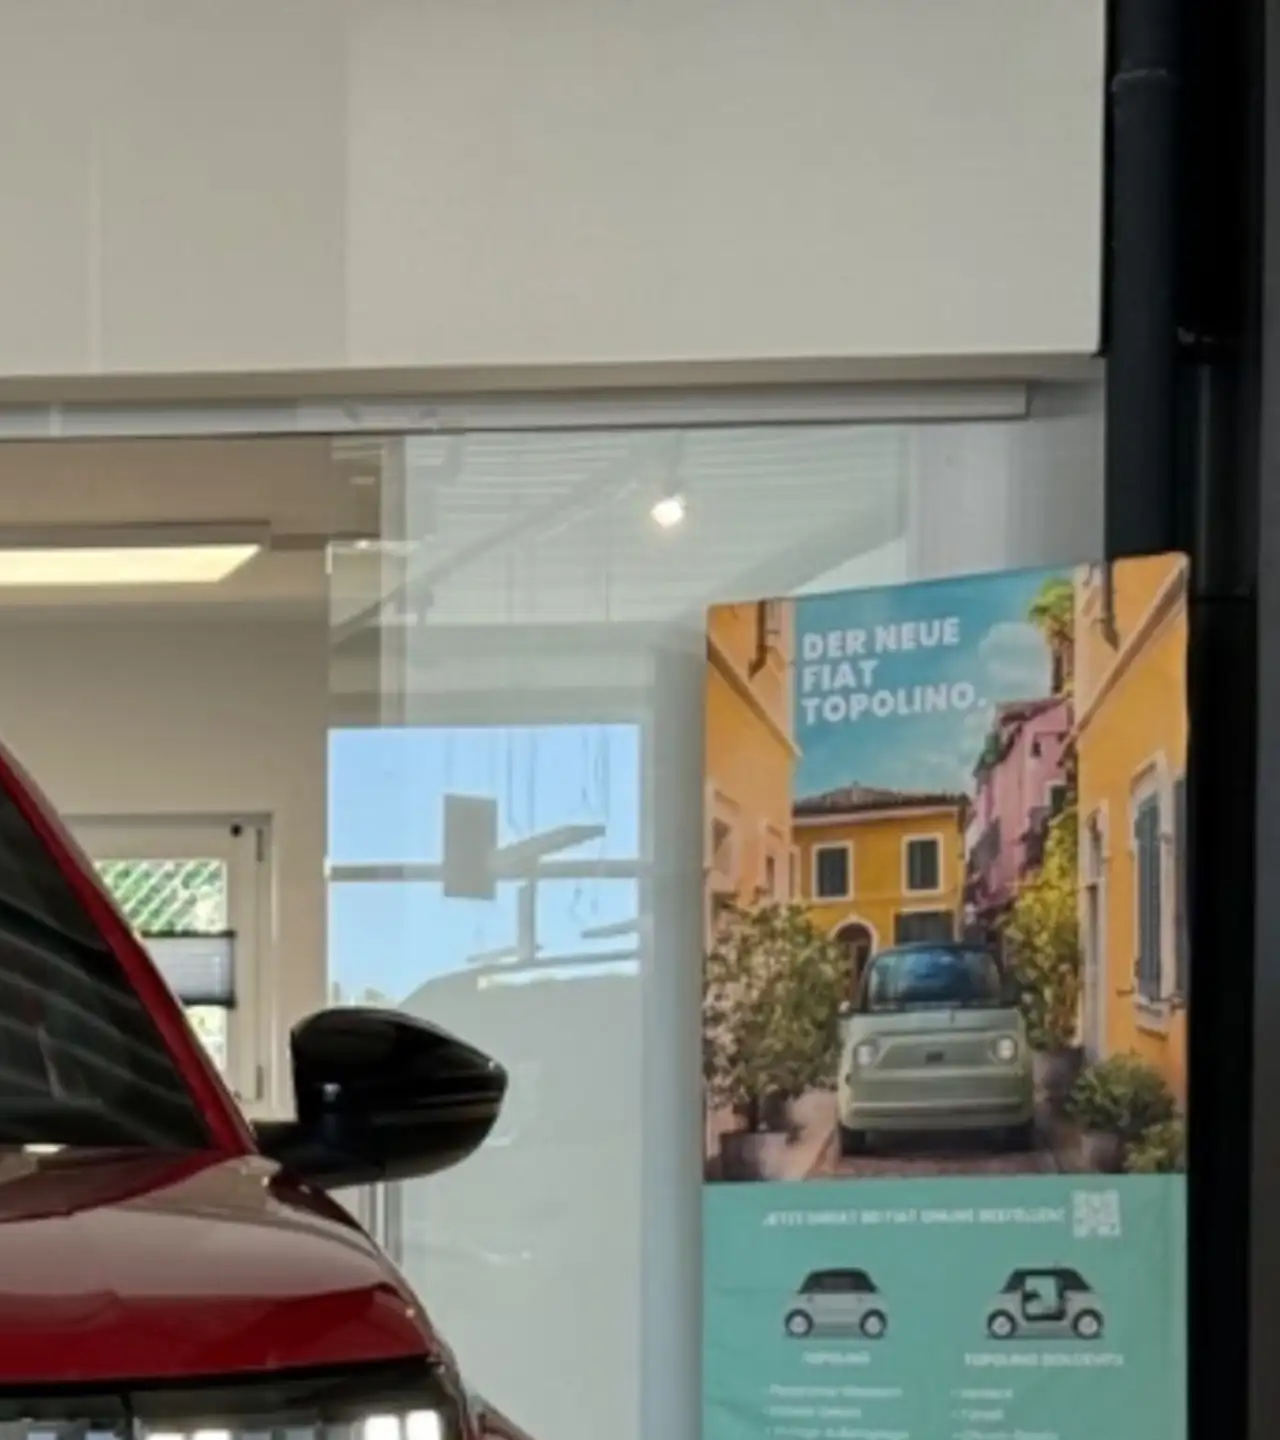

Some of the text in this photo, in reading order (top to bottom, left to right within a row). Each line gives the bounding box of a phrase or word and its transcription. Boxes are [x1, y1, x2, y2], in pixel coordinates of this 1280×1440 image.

[802, 616, 960, 661] DER NEUE
[802, 659, 880, 694] FIAT
[801, 682, 987, 726] TOPOLINO.
